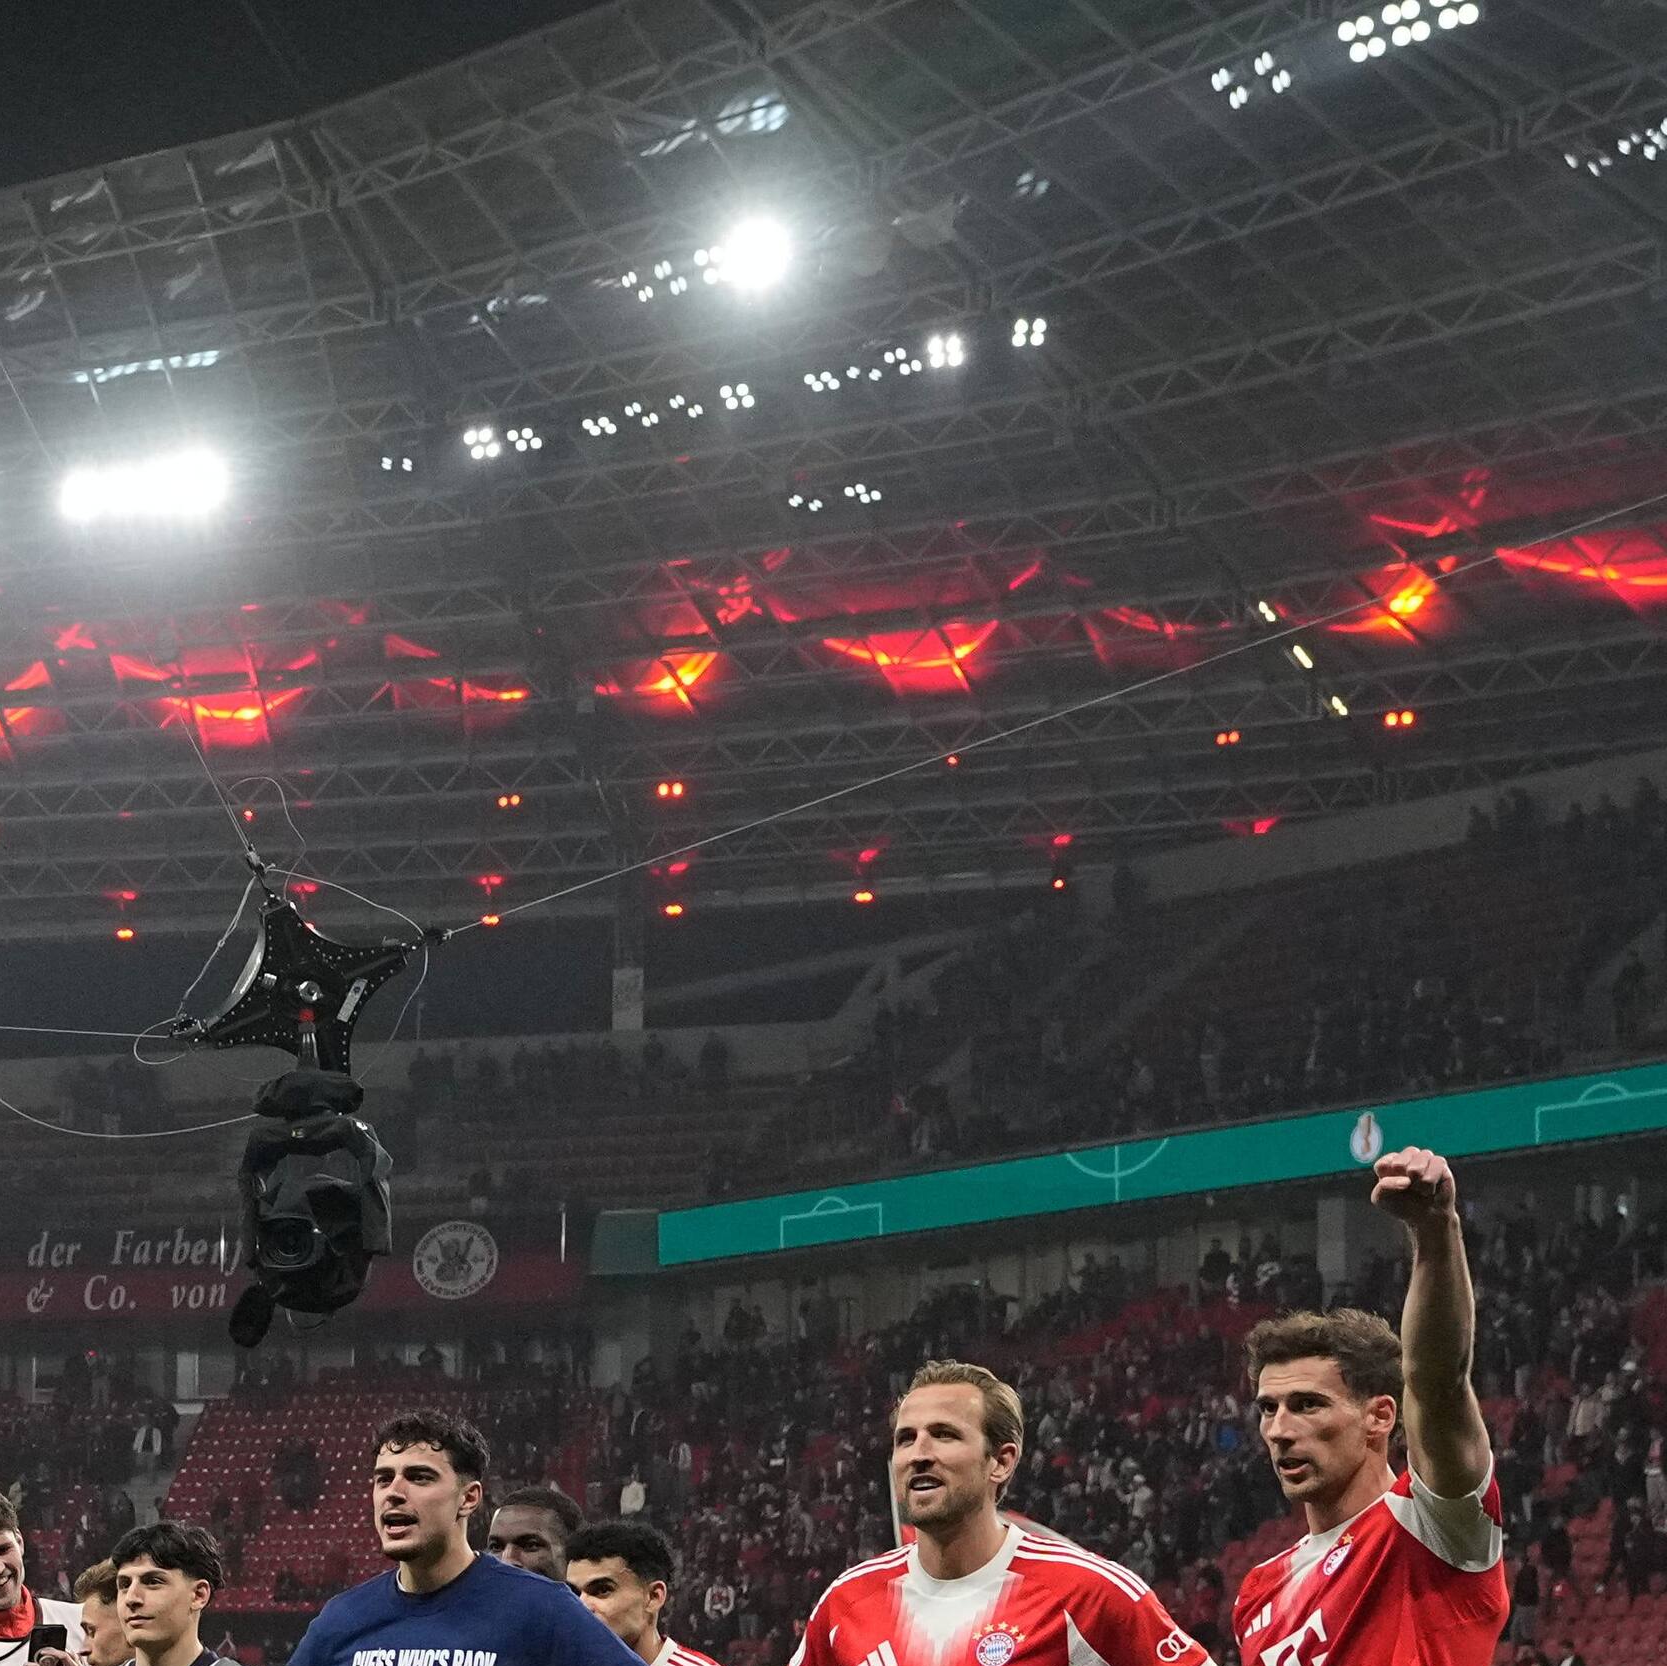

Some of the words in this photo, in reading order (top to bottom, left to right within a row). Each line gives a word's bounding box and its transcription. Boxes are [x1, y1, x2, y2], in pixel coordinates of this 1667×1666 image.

[28, 1232, 81, 1269] der
[28, 1279, 56, 1313] &
[83, 1274, 137, 1311] Co.
[172, 1282, 227, 1309] von
